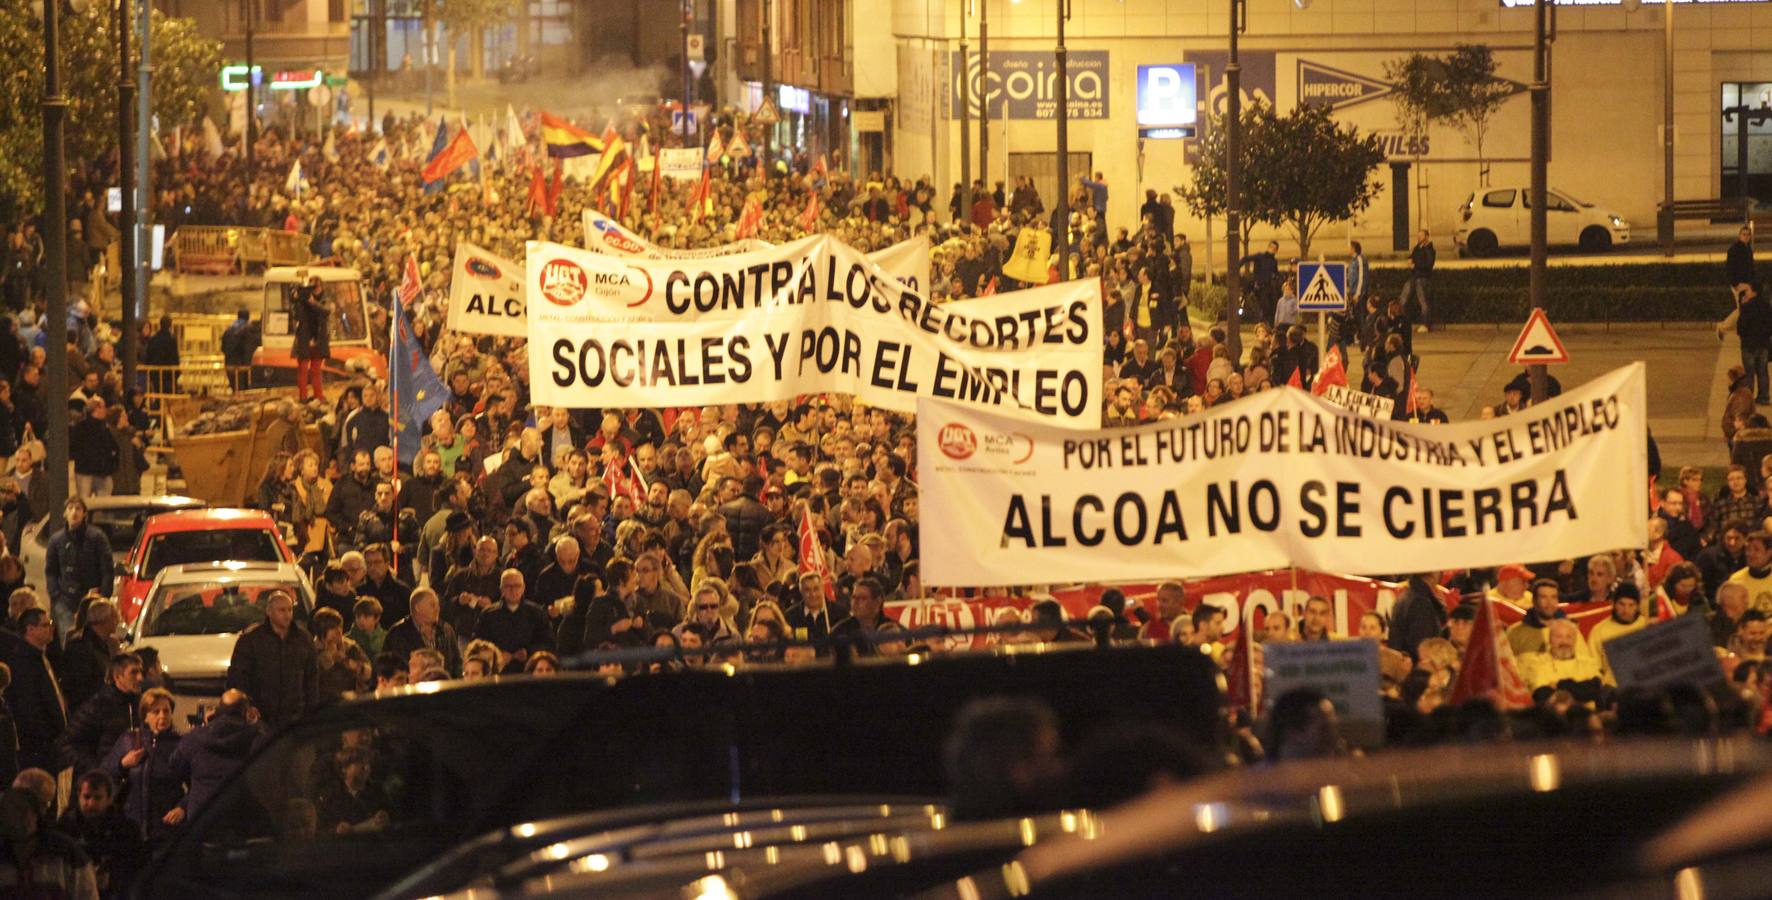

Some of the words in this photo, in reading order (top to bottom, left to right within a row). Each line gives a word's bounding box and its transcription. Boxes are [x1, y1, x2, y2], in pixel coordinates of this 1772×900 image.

[1148, 67, 1181, 110] P
[1304, 83, 1363, 97] HIPERCOR
[545, 263, 584, 290] UGT
[594, 273, 630, 287] MCA
[466, 293, 527, 318] ALC
[666, 256, 816, 314] CONTRA
[826, 255, 891, 313] LOS
[898, 290, 1089, 350] RECORTES
[552, 335, 753, 388] SOCIALES
[764, 331, 790, 381] Y
[798, 326, 862, 378] POR
[870, 340, 919, 393] EL
[932, 351, 1089, 416] EMPLEO
[984, 434, 1013, 445] MCA
[1064, 438, 1112, 470] POR
[1121, 433, 1148, 466] EL
[1156, 414, 1250, 465] FUTURO
[1259, 411, 1290, 453] DE
[1300, 411, 1328, 454] LA
[1335, 413, 1467, 467] INDUSTRIA
[1468, 437, 1486, 467] Y
[1494, 429, 1523, 464] EL
[1528, 393, 1620, 455] EMPLEO
[1001, 489, 1188, 549] ALCOA
[1207, 479, 1281, 538] NO
[1300, 480, 1363, 538] SE
[1383, 468, 1578, 540] CIERRA
